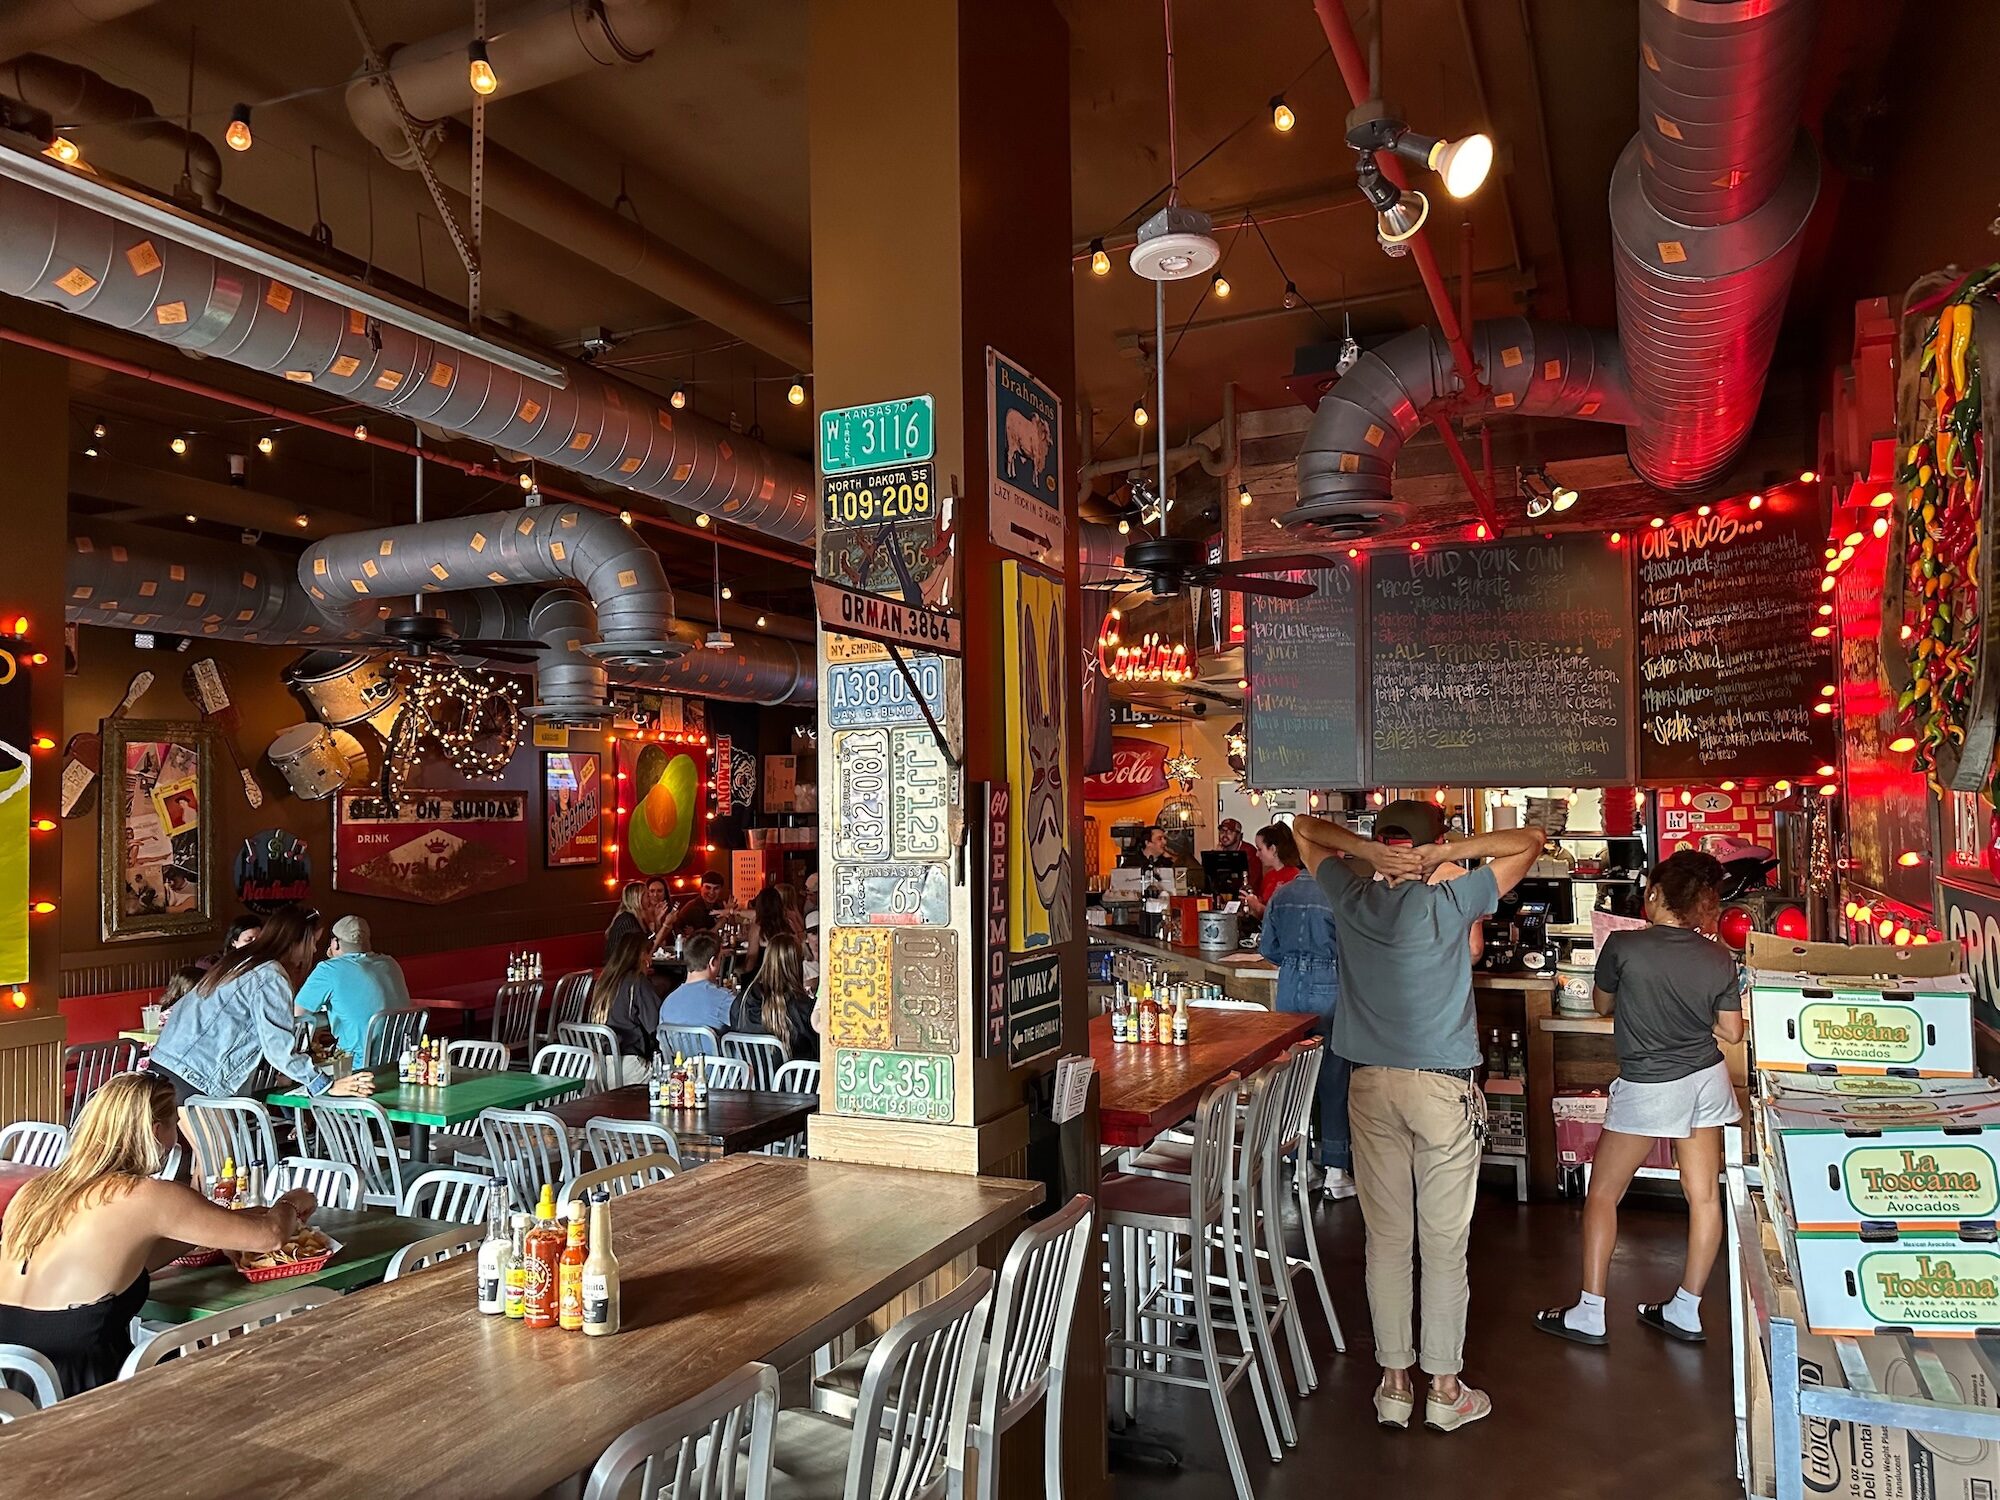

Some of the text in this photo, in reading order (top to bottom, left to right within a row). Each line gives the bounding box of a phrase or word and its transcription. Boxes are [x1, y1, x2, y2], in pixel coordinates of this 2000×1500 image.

[1001, 367, 1055, 421] Brahmans
[845, 402, 908, 420] KANSAS 70
[862, 412, 920, 454] 3116
[828, 470, 928, 492] NORTH DAKOTA 55
[827, 482, 930, 522] 109-209
[994, 484, 1062, 530] LAZY ROCKIN S RANCH
[1642, 527, 1678, 560] OUR
[1410, 545, 1564, 578] BUILD YOUR OWN
[851, 643, 884, 655] EMPIRE
[1099, 611, 1193, 682] Cantina
[1429, 642, 1500, 661] TOPPINGS
[835, 711, 856, 719] JAN
[718, 738, 731, 816] BELMONT
[1101, 752, 1153, 785] Cola
[843, 769, 851, 816] SUBURBAN
[895, 732, 906, 853] NORTH CAROLINA
[991, 789, 1008, 817] GO
[416, 800, 440, 819] ON
[452, 800, 519, 819] SUNDAY
[358, 834, 390, 843] DRINK
[575, 834, 598, 845] ORANGES
[380, 857, 430, 880] oyal
[858, 865, 907, 878] KANSAS
[891, 877, 922, 915] 65
[990, 821, 1006, 1045] BELMONT
[833, 951, 843, 1017] TRUCK
[843, 935, 877, 1020] 2355
[899, 936, 943, 1017] 920
[1011, 970, 1048, 1003] MY WAY
[1023, 1017, 1059, 1046] THE HIGHWAY
[1813, 1019, 1909, 1043] Toscana
[1847, 1007, 1876, 1026] La
[1831, 1046, 1891, 1059] Avocados
[1900, 1150, 1939, 1174] La
[1861, 1166, 1982, 1193] Toscana
[1887, 1200, 1960, 1213] Avocados
[1916, 1256, 1956, 1279] La
[1876, 1271, 1999, 1299] Toscana
[1903, 1307, 1977, 1319] Avocados
[1860, 1424, 1877, 1499] Deli Contai
[1880, 1425, 1893, 1498] Heavy Weight Plast
[1850, 1467, 1860, 1498] 16 oz
[1893, 1455, 1904, 1499] Translucent
